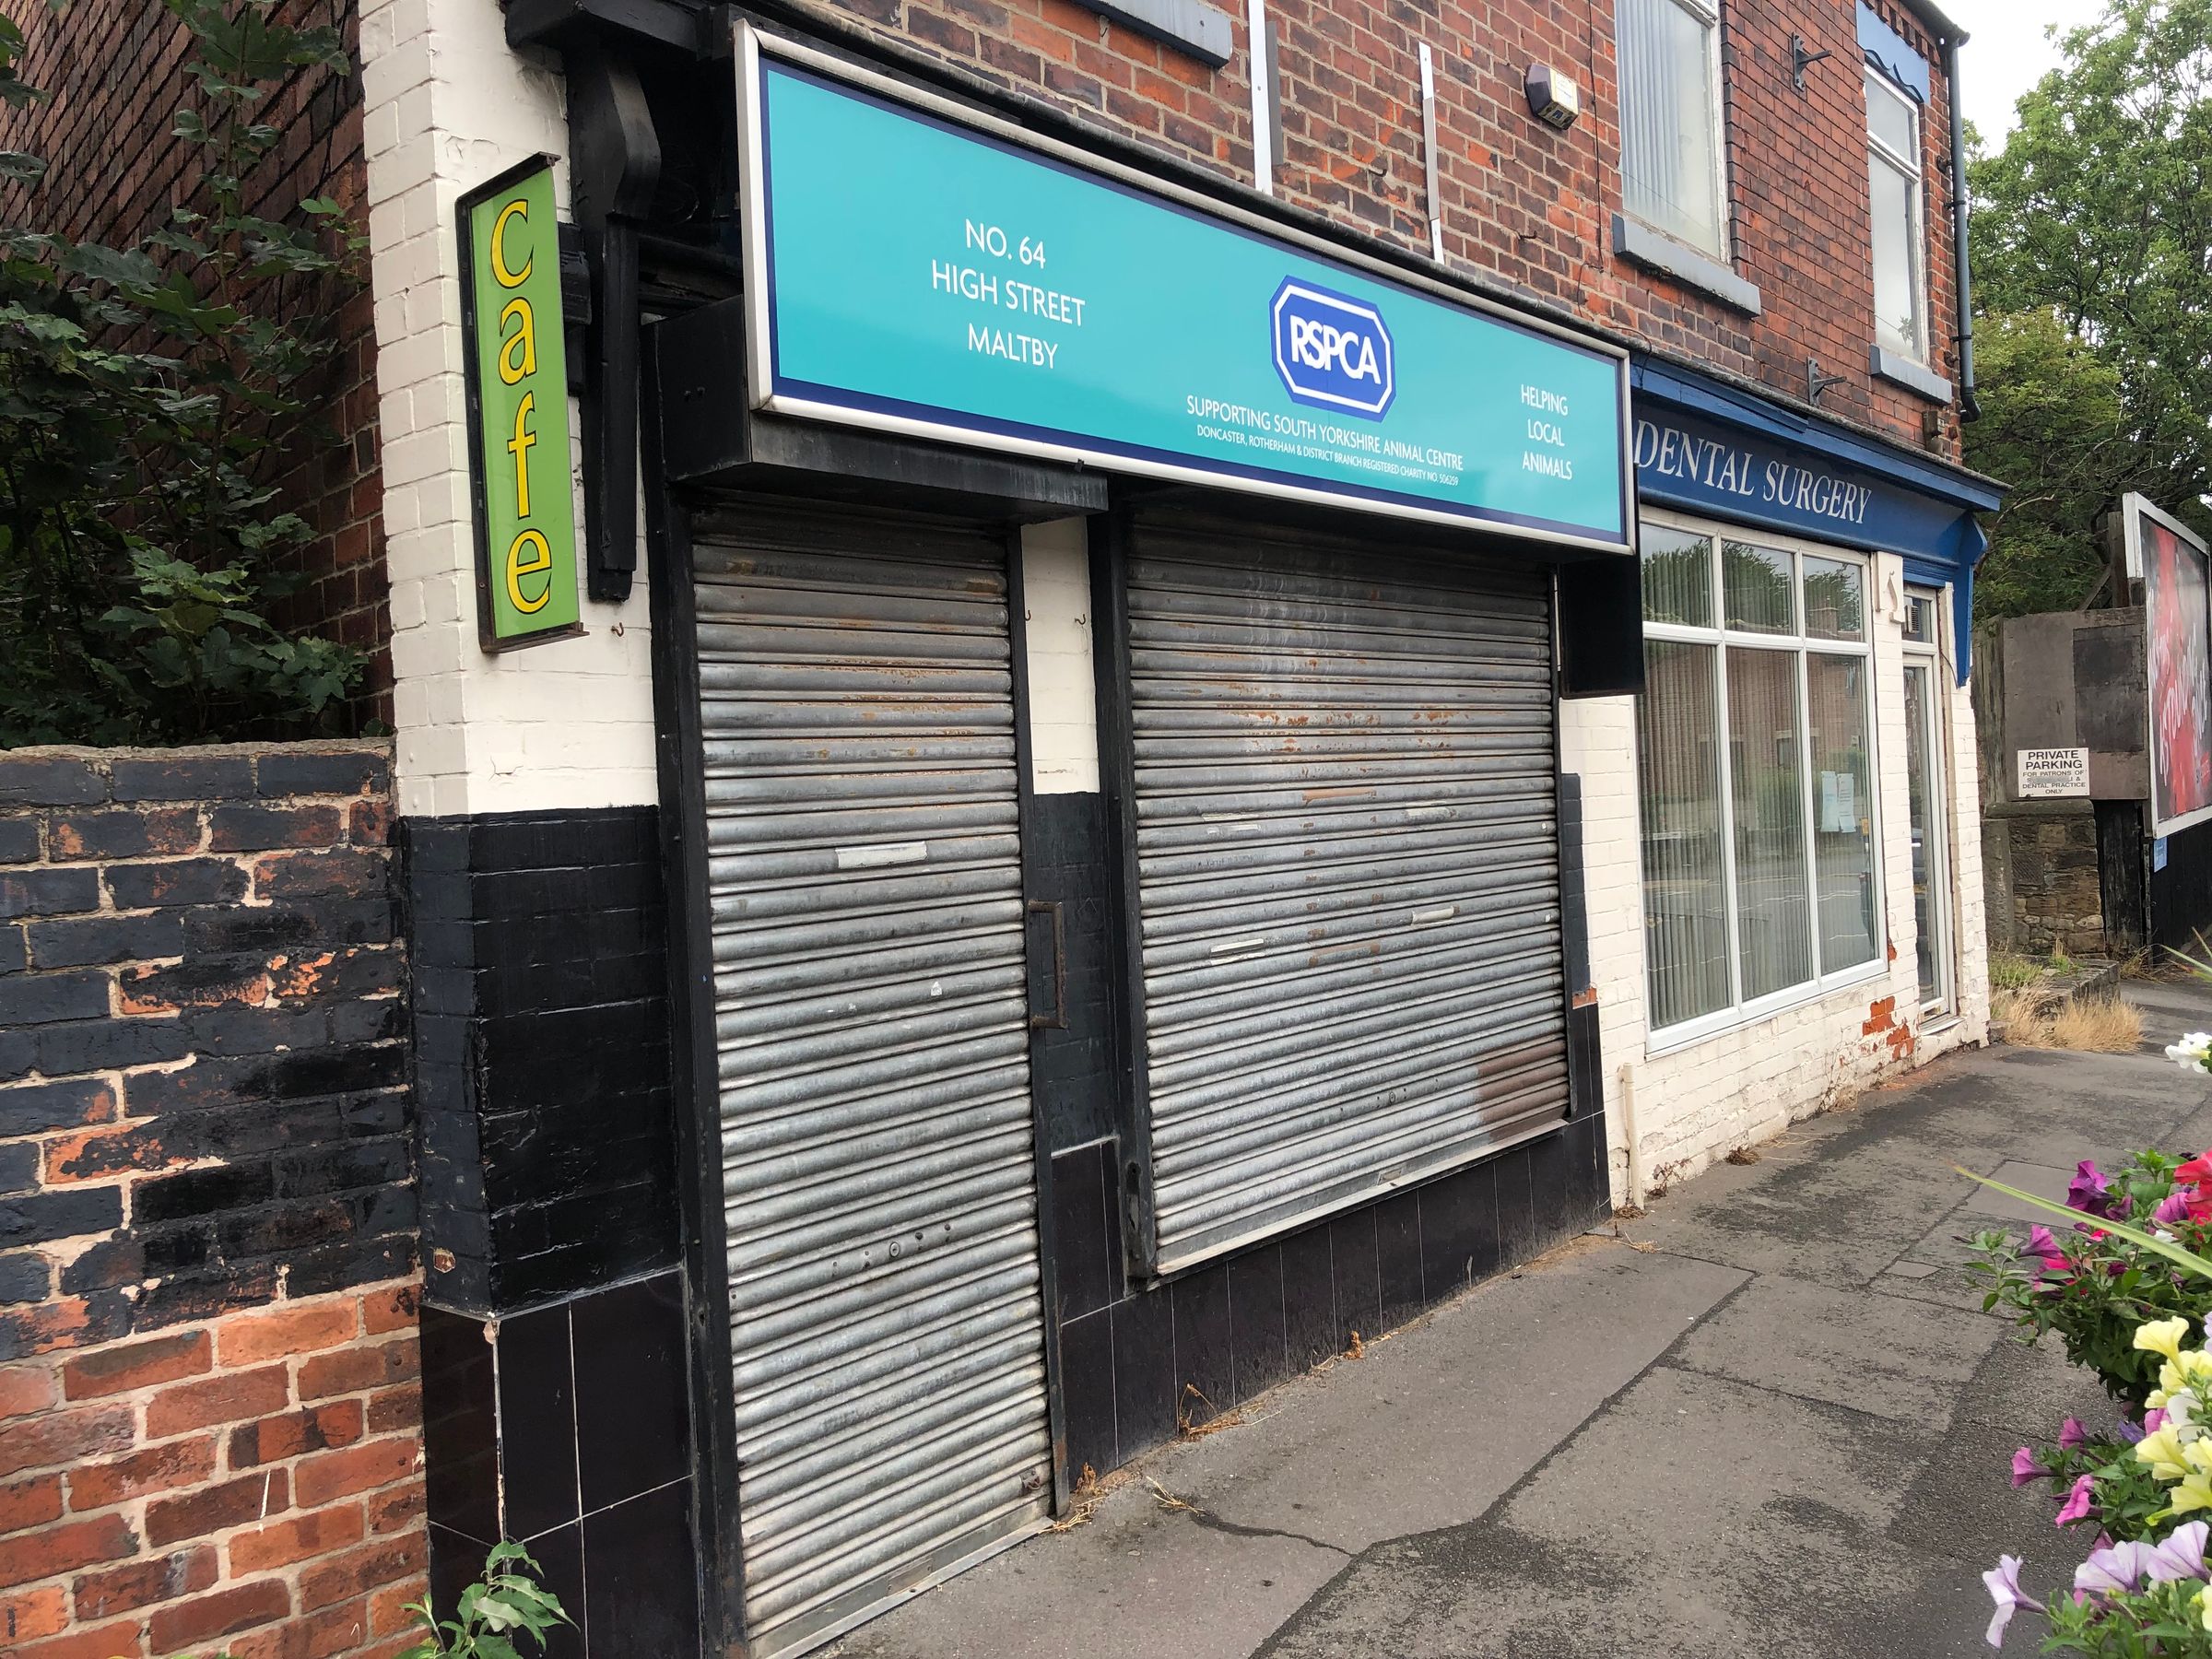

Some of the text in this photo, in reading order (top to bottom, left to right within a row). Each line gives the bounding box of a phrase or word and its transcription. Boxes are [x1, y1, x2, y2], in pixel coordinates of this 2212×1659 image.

[965, 218, 1046, 269] NO. 64
[932, 259, 1086, 326] HIGH STREET
[968, 323, 1058, 369] MALTBY
[1289, 314, 1382, 385] RSPCA
[490, 197, 553, 615] cafe
[1521, 383, 1569, 416] HELPING
[1186, 394, 1464, 472] SUPPORTING SOUTH YORKSHIRE ANIMAL CENTRE
[1196, 424, 1248, 447] DONCASTER,
[1248, 434, 1296, 454] ROTHERHAM
[1296, 445, 1302, 456] &
[1303, 445, 1334, 462] DISTRICT
[1334, 452, 1362, 467] BRANCH
[1362, 458, 1400, 475] REGISTERED
[1400, 465, 1427, 479] CHARITY
[1527, 418, 1565, 447] LOCAL
[1522, 450, 1572, 480] ANIMALS
[1634, 419, 1872, 524] DENTAL SURGERY
[2026, 760, 2082, 770] PARKING
[2029, 750, 2078, 760] PRIVATE
